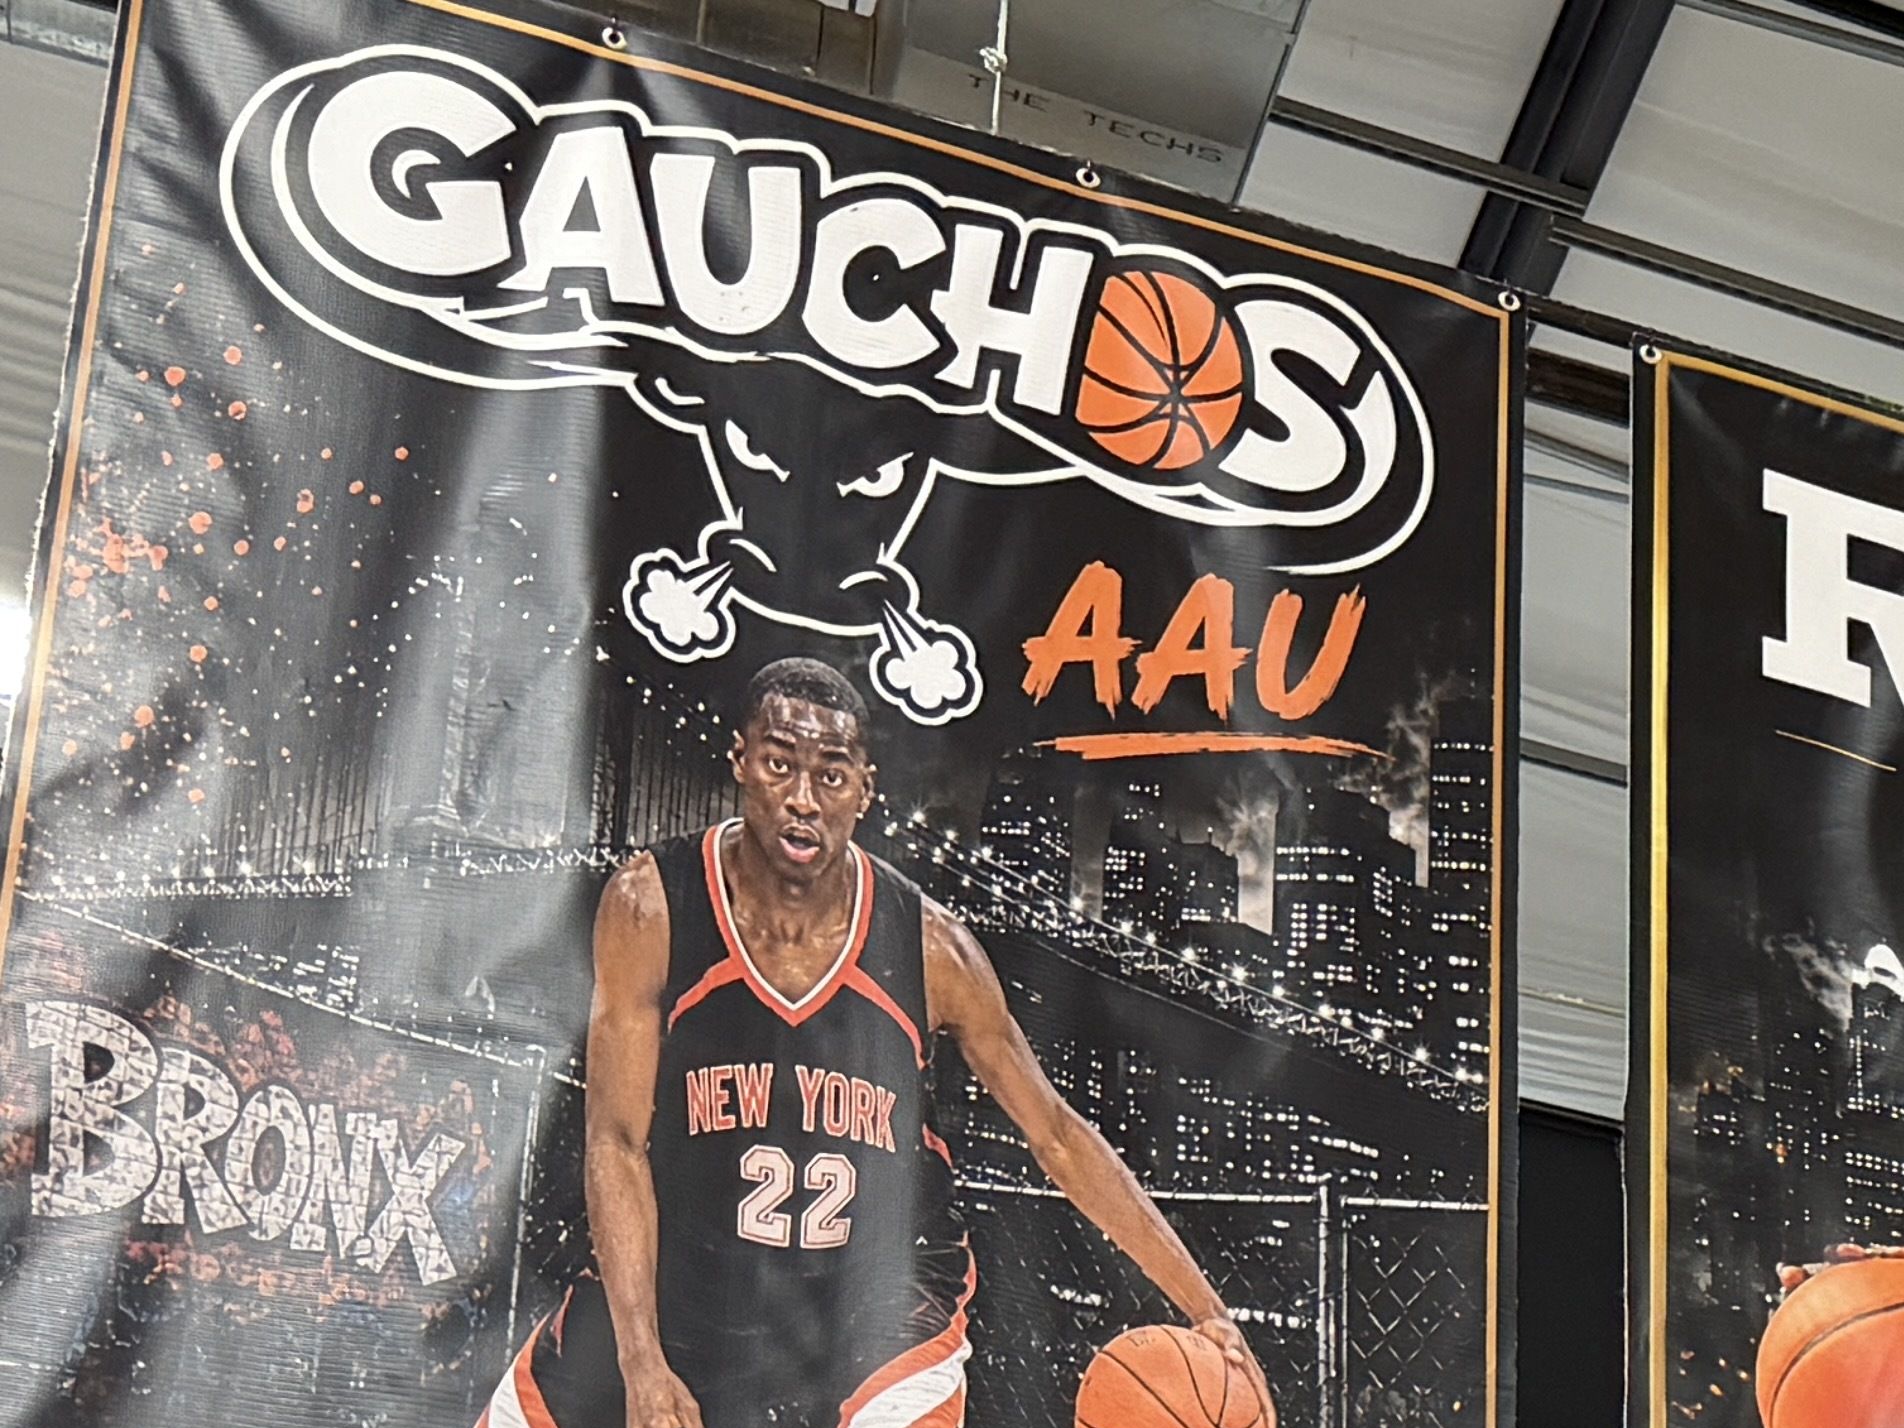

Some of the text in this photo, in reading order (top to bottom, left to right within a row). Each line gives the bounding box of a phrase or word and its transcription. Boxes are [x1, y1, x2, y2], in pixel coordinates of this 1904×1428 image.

[1083, 110, 1225, 164] TECHS
[306, 68, 1397, 495] GAUCHOS
[1021, 560, 1367, 724] AAU
[25, 1000, 466, 1286] BRONX
[686, 1062, 899, 1152] NEW YORK
[737, 1146, 858, 1250] 22
